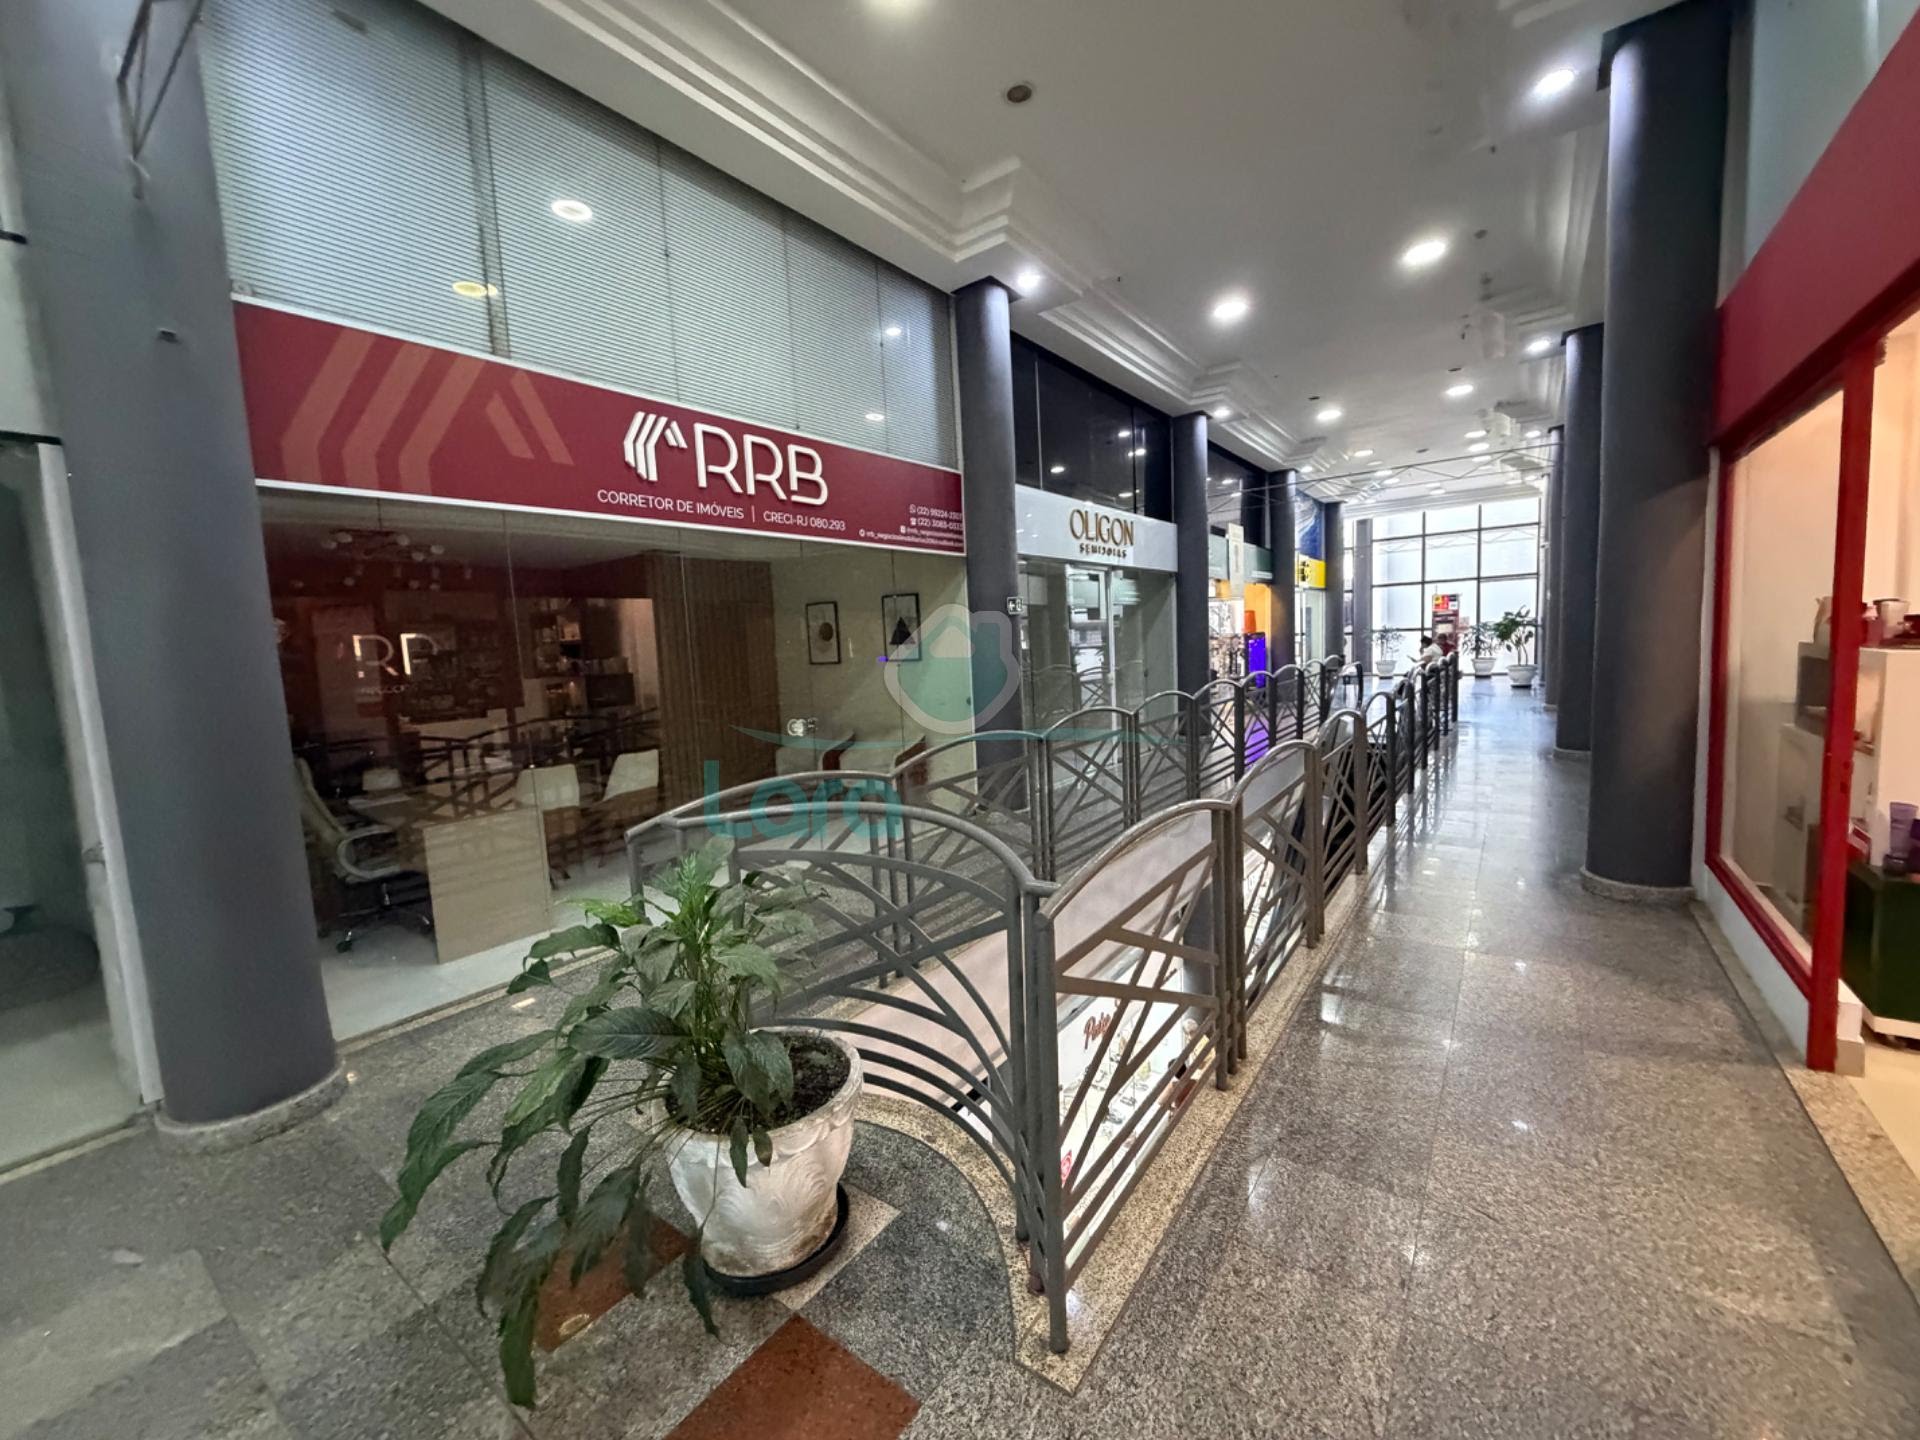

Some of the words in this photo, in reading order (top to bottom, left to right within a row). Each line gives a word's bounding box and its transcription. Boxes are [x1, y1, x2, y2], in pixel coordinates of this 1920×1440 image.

[693, 421, 829, 506] RRB
[597, 488, 674, 511] CORRETOR
[677, 499, 694, 514] DE
[696, 500, 744, 520] IMÓVEIS
[763, 509, 808, 528] CRECI-RJ
[810, 515, 846, 532] 080.293
[1069, 508, 1134, 546] OLIGON
